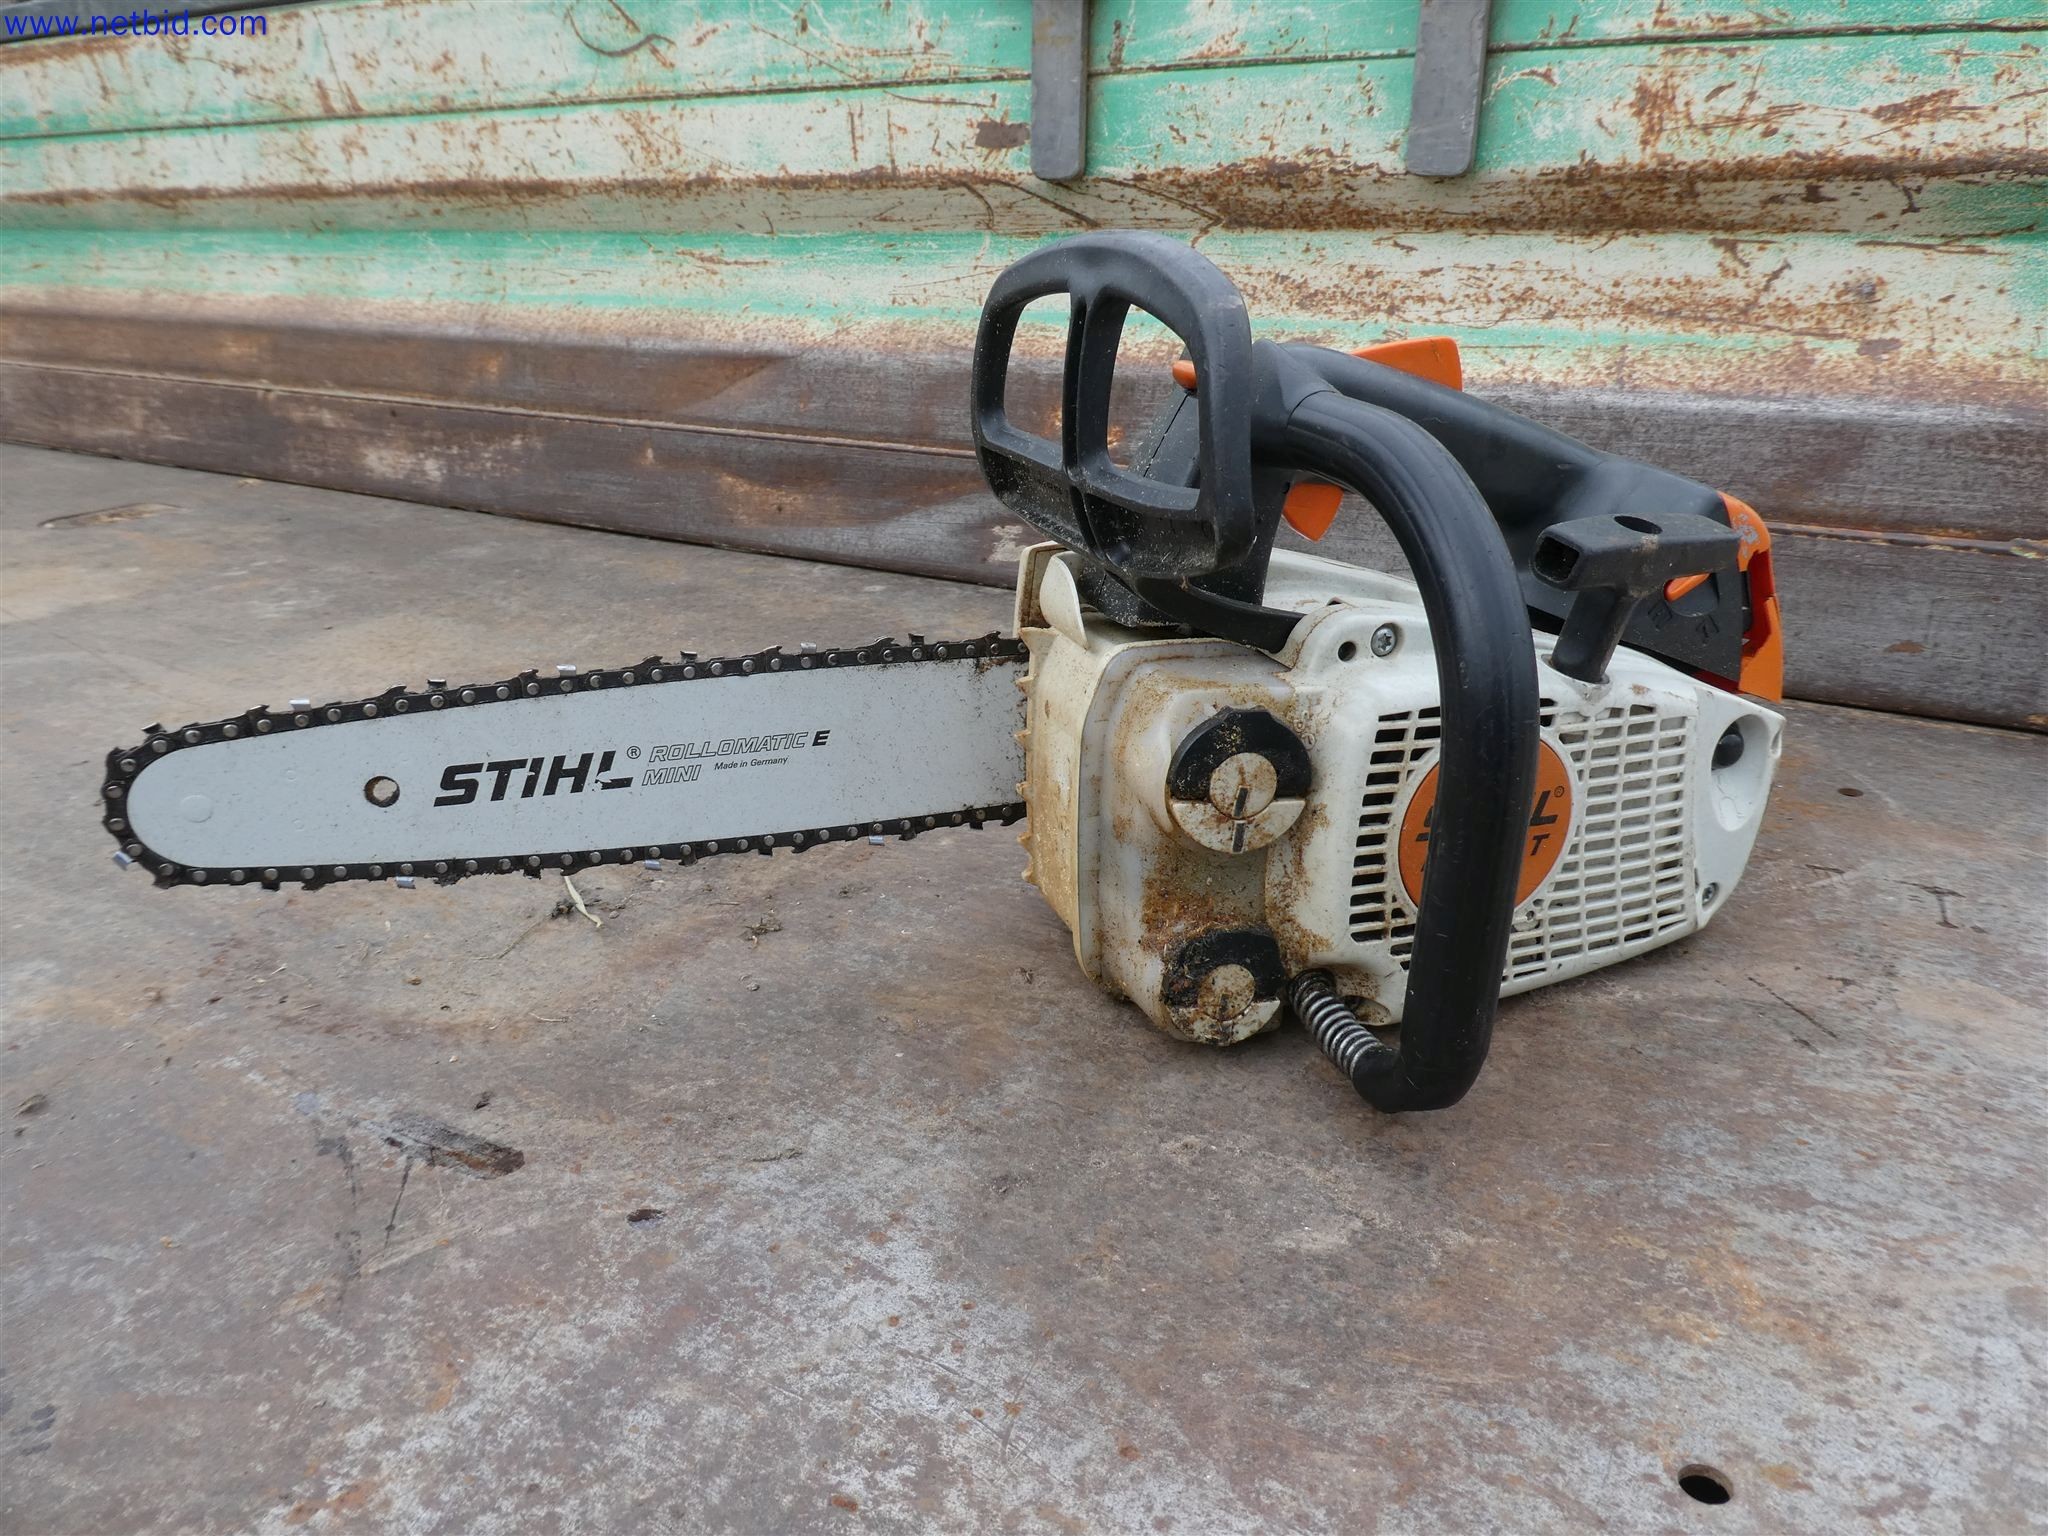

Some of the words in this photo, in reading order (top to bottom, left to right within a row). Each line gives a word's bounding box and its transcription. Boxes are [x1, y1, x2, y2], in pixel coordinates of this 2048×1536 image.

[649, 731, 808, 762] ROLLOMATIC
[812, 730, 831, 747] E
[642, 764, 702, 786] MINI
[714, 759, 738, 771] Made
[739, 760, 748, 768] in
[750, 757, 788, 768] Germany
[433, 750, 634, 807] STIHL
